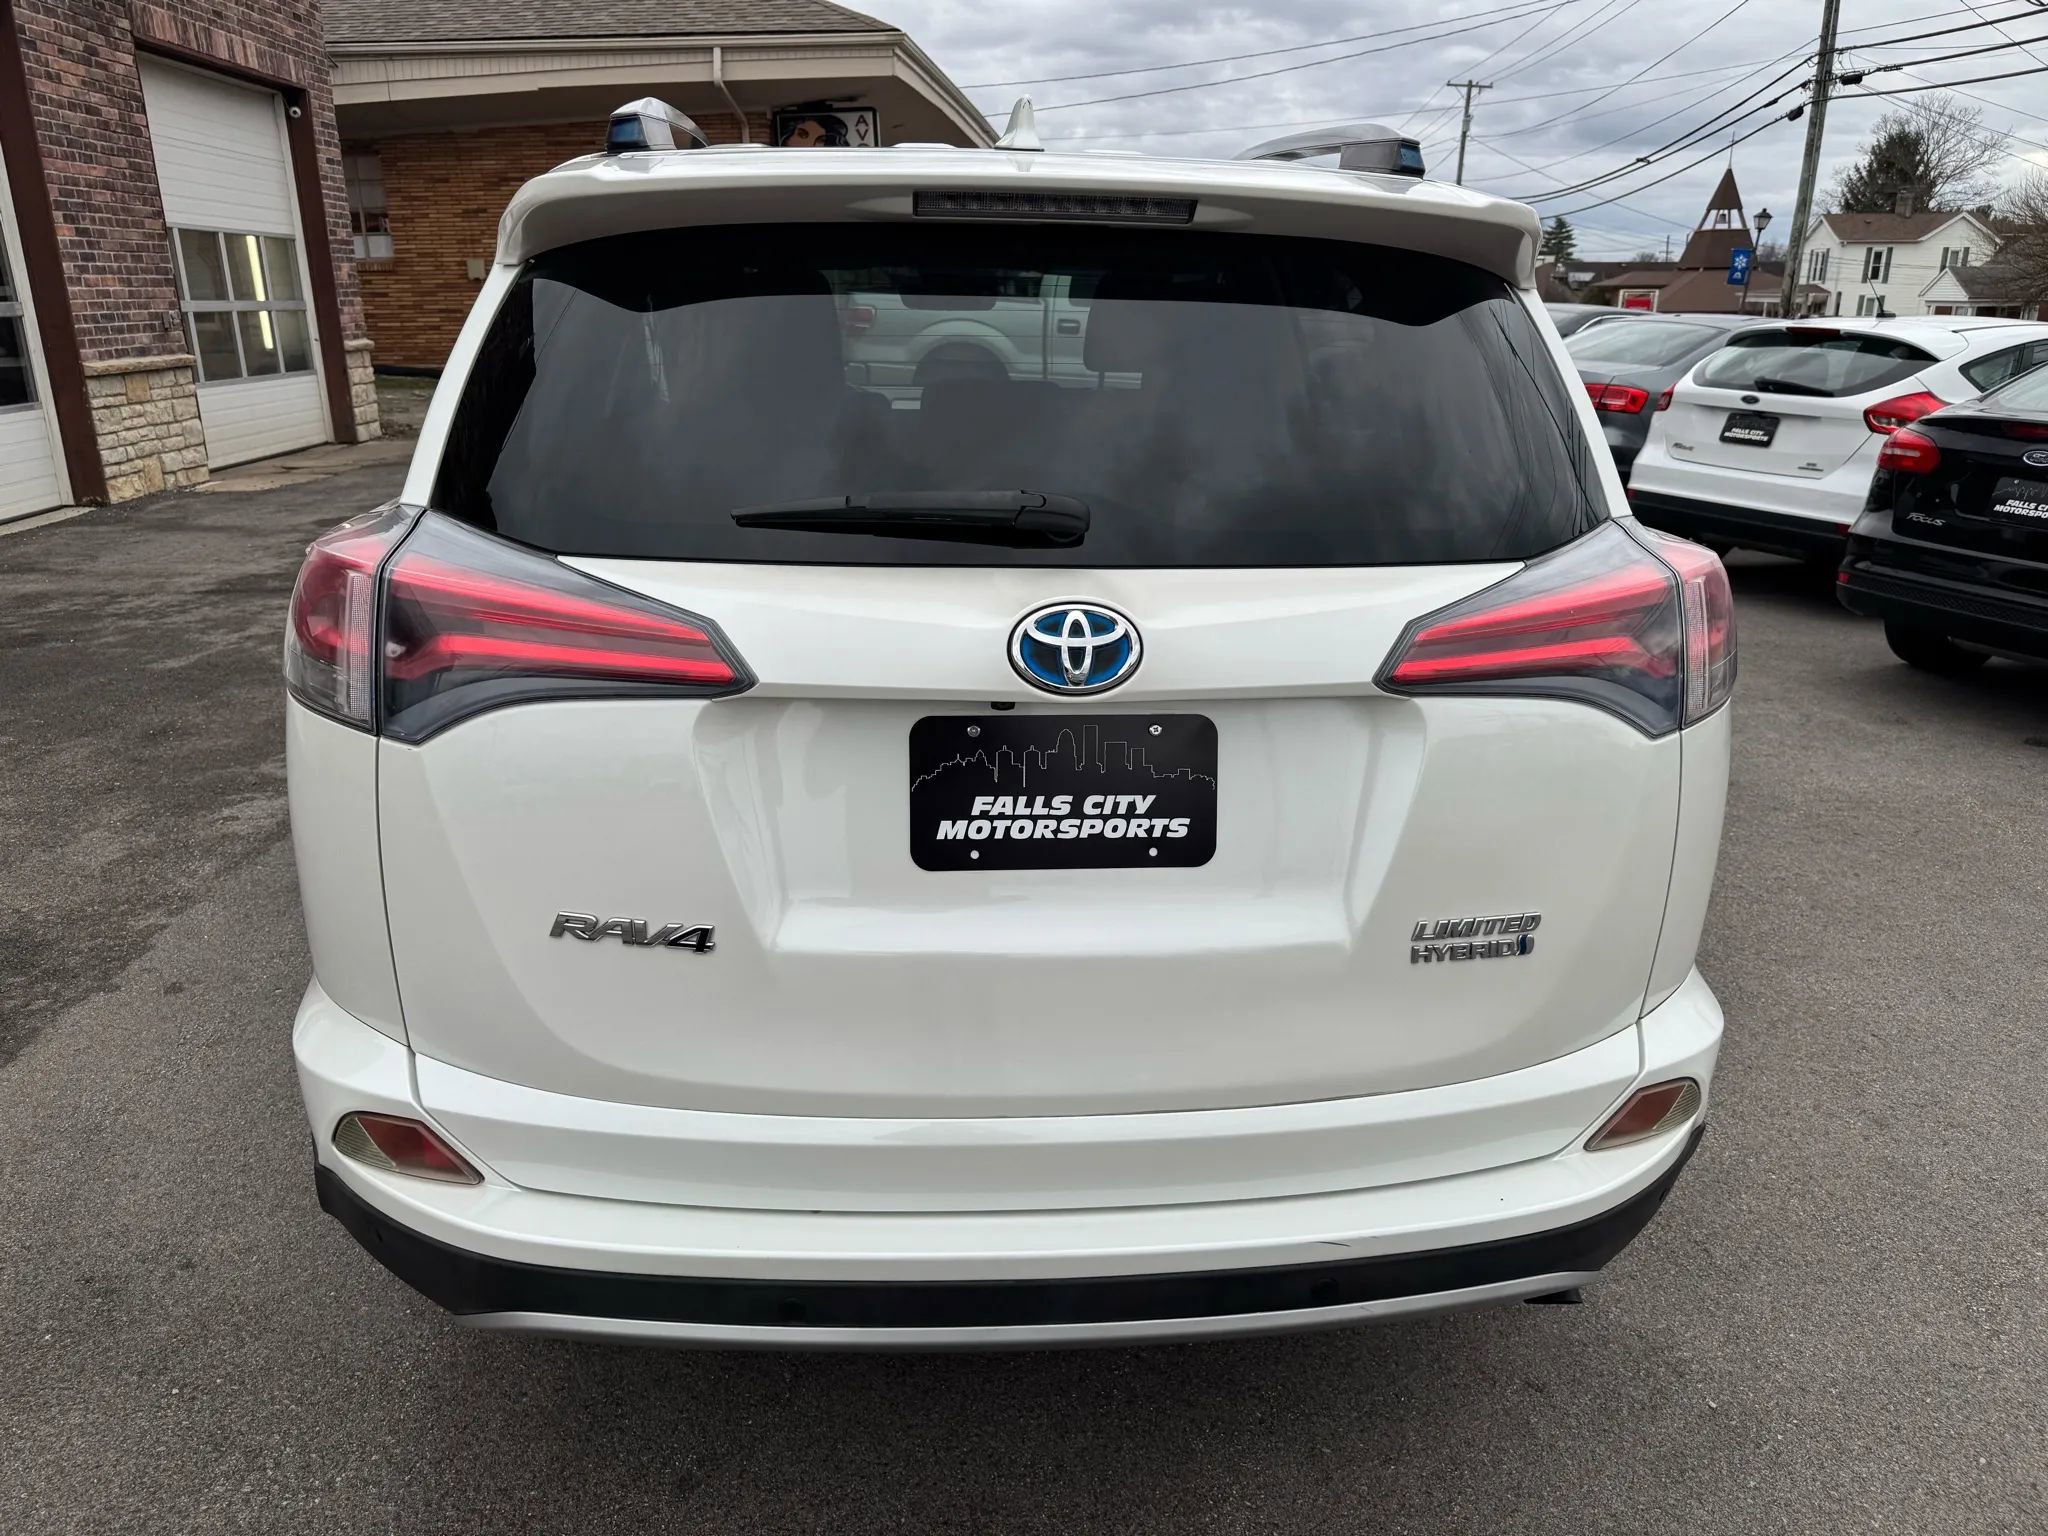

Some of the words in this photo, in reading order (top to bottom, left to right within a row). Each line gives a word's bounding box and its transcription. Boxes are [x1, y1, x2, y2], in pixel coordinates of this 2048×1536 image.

[2006, 499, 2037, 510] FALLS
[1905, 512, 1947, 527] FOCUS
[970, 795, 1073, 816] FALLS
[1082, 794, 1157, 815] CITY
[936, 817, 1191, 840] MOTORSPORTS
[549, 911, 717, 955] RAV4
[1410, 911, 1542, 942] LIMITED
[1410, 938, 1516, 965] HYBRID
